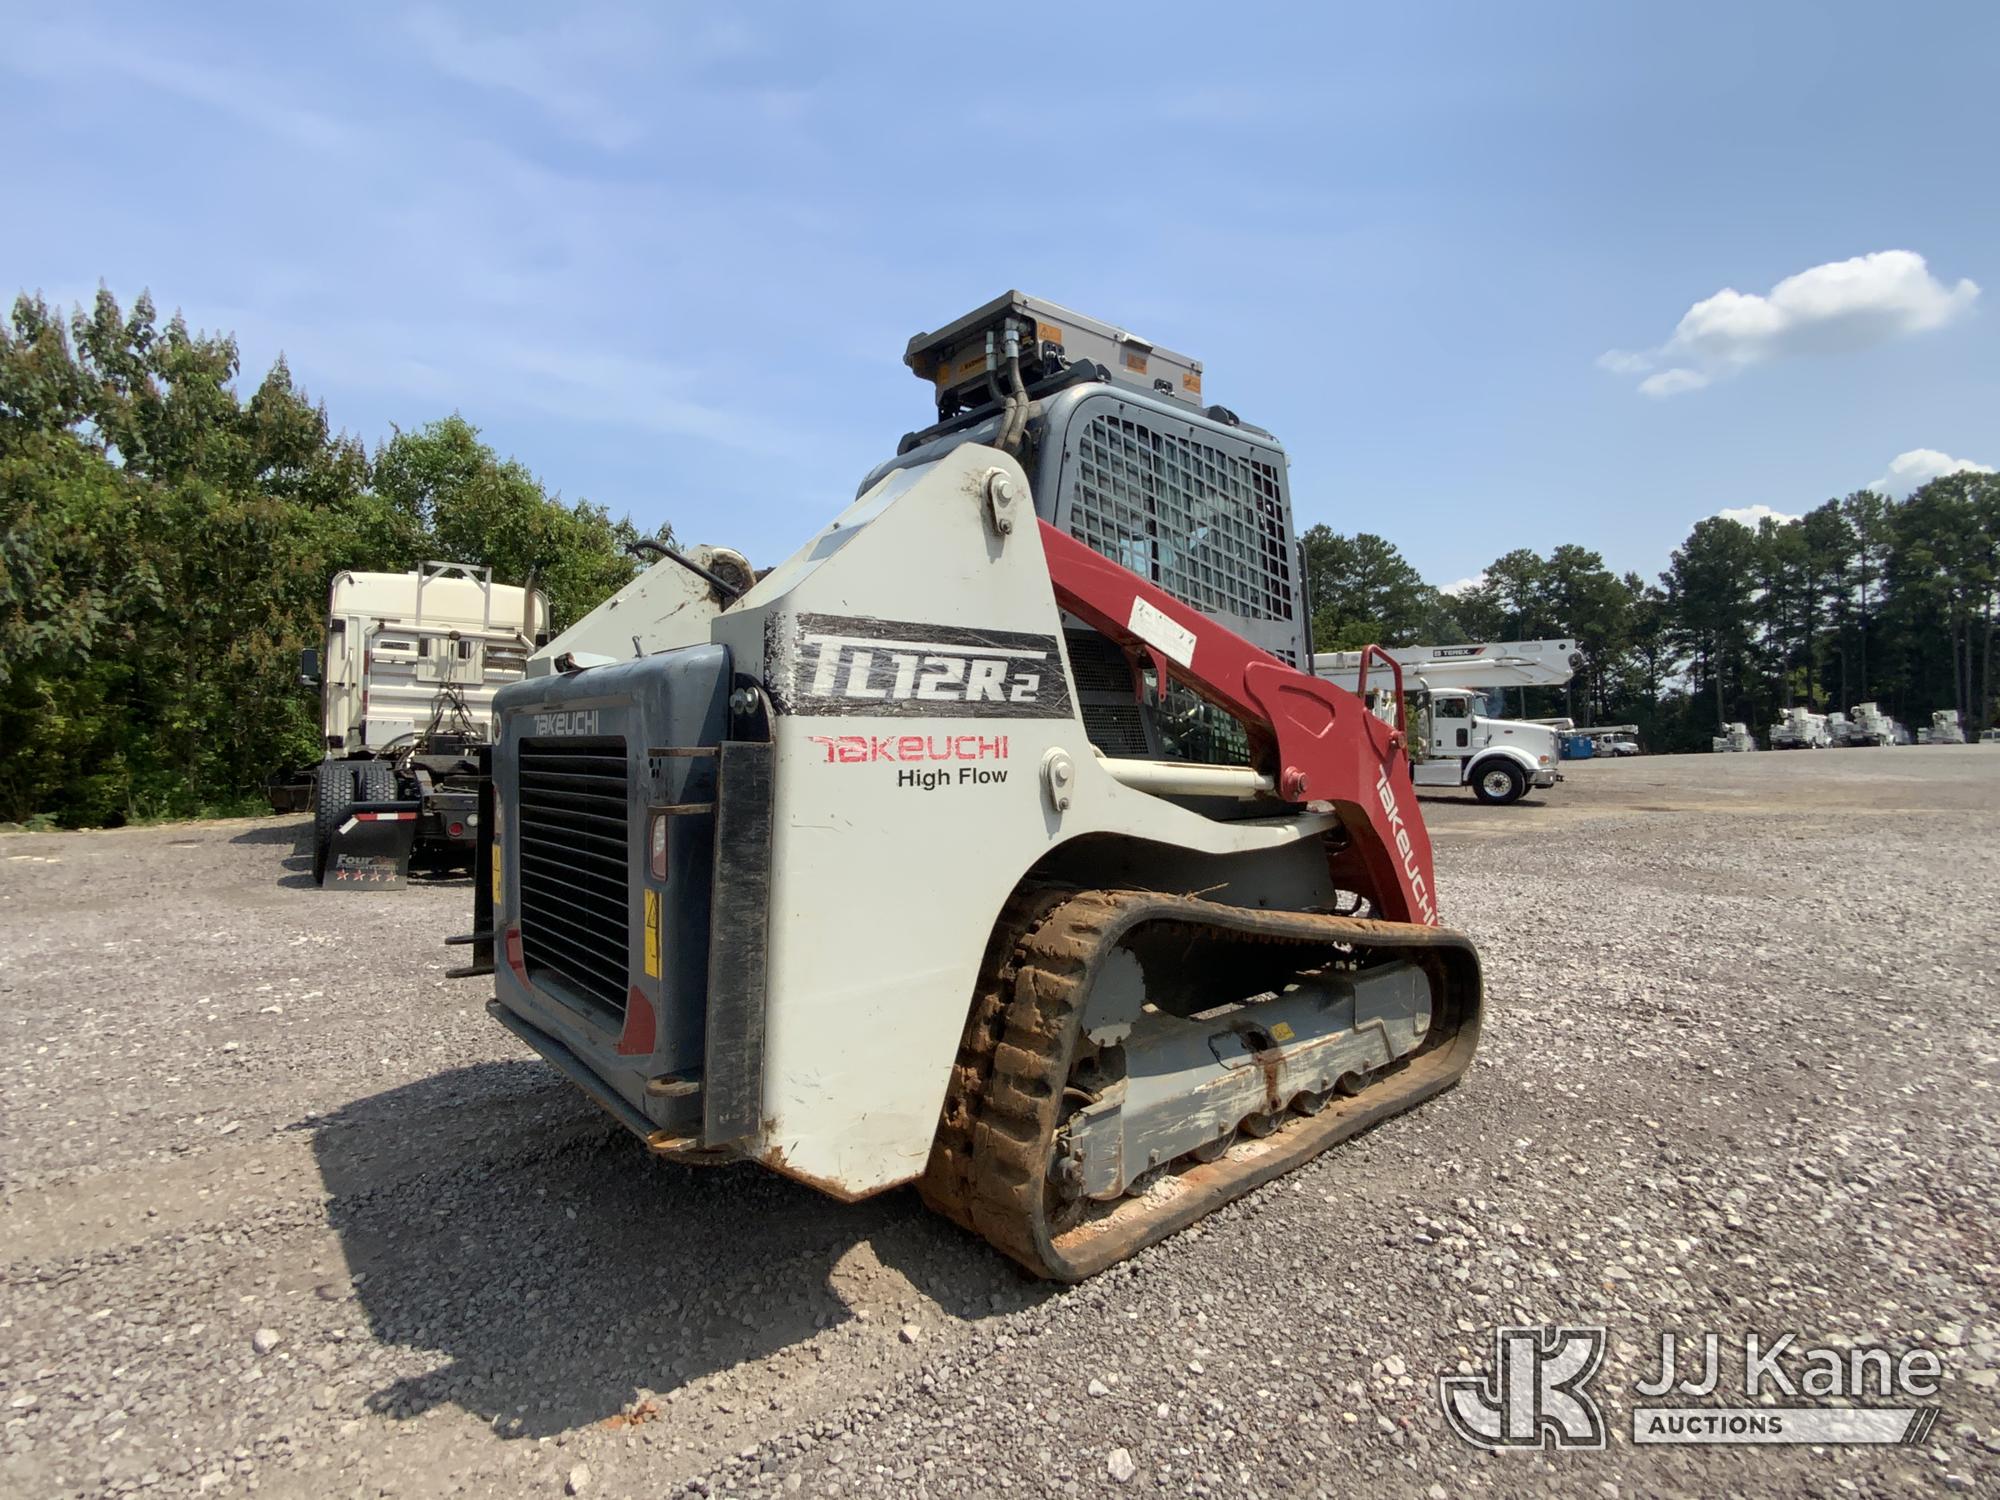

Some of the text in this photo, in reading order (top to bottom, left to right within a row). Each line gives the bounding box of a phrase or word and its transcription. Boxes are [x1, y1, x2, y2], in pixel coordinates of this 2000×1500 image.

[898, 767, 1008, 790] High Flow
[337, 853, 373, 865] Four
